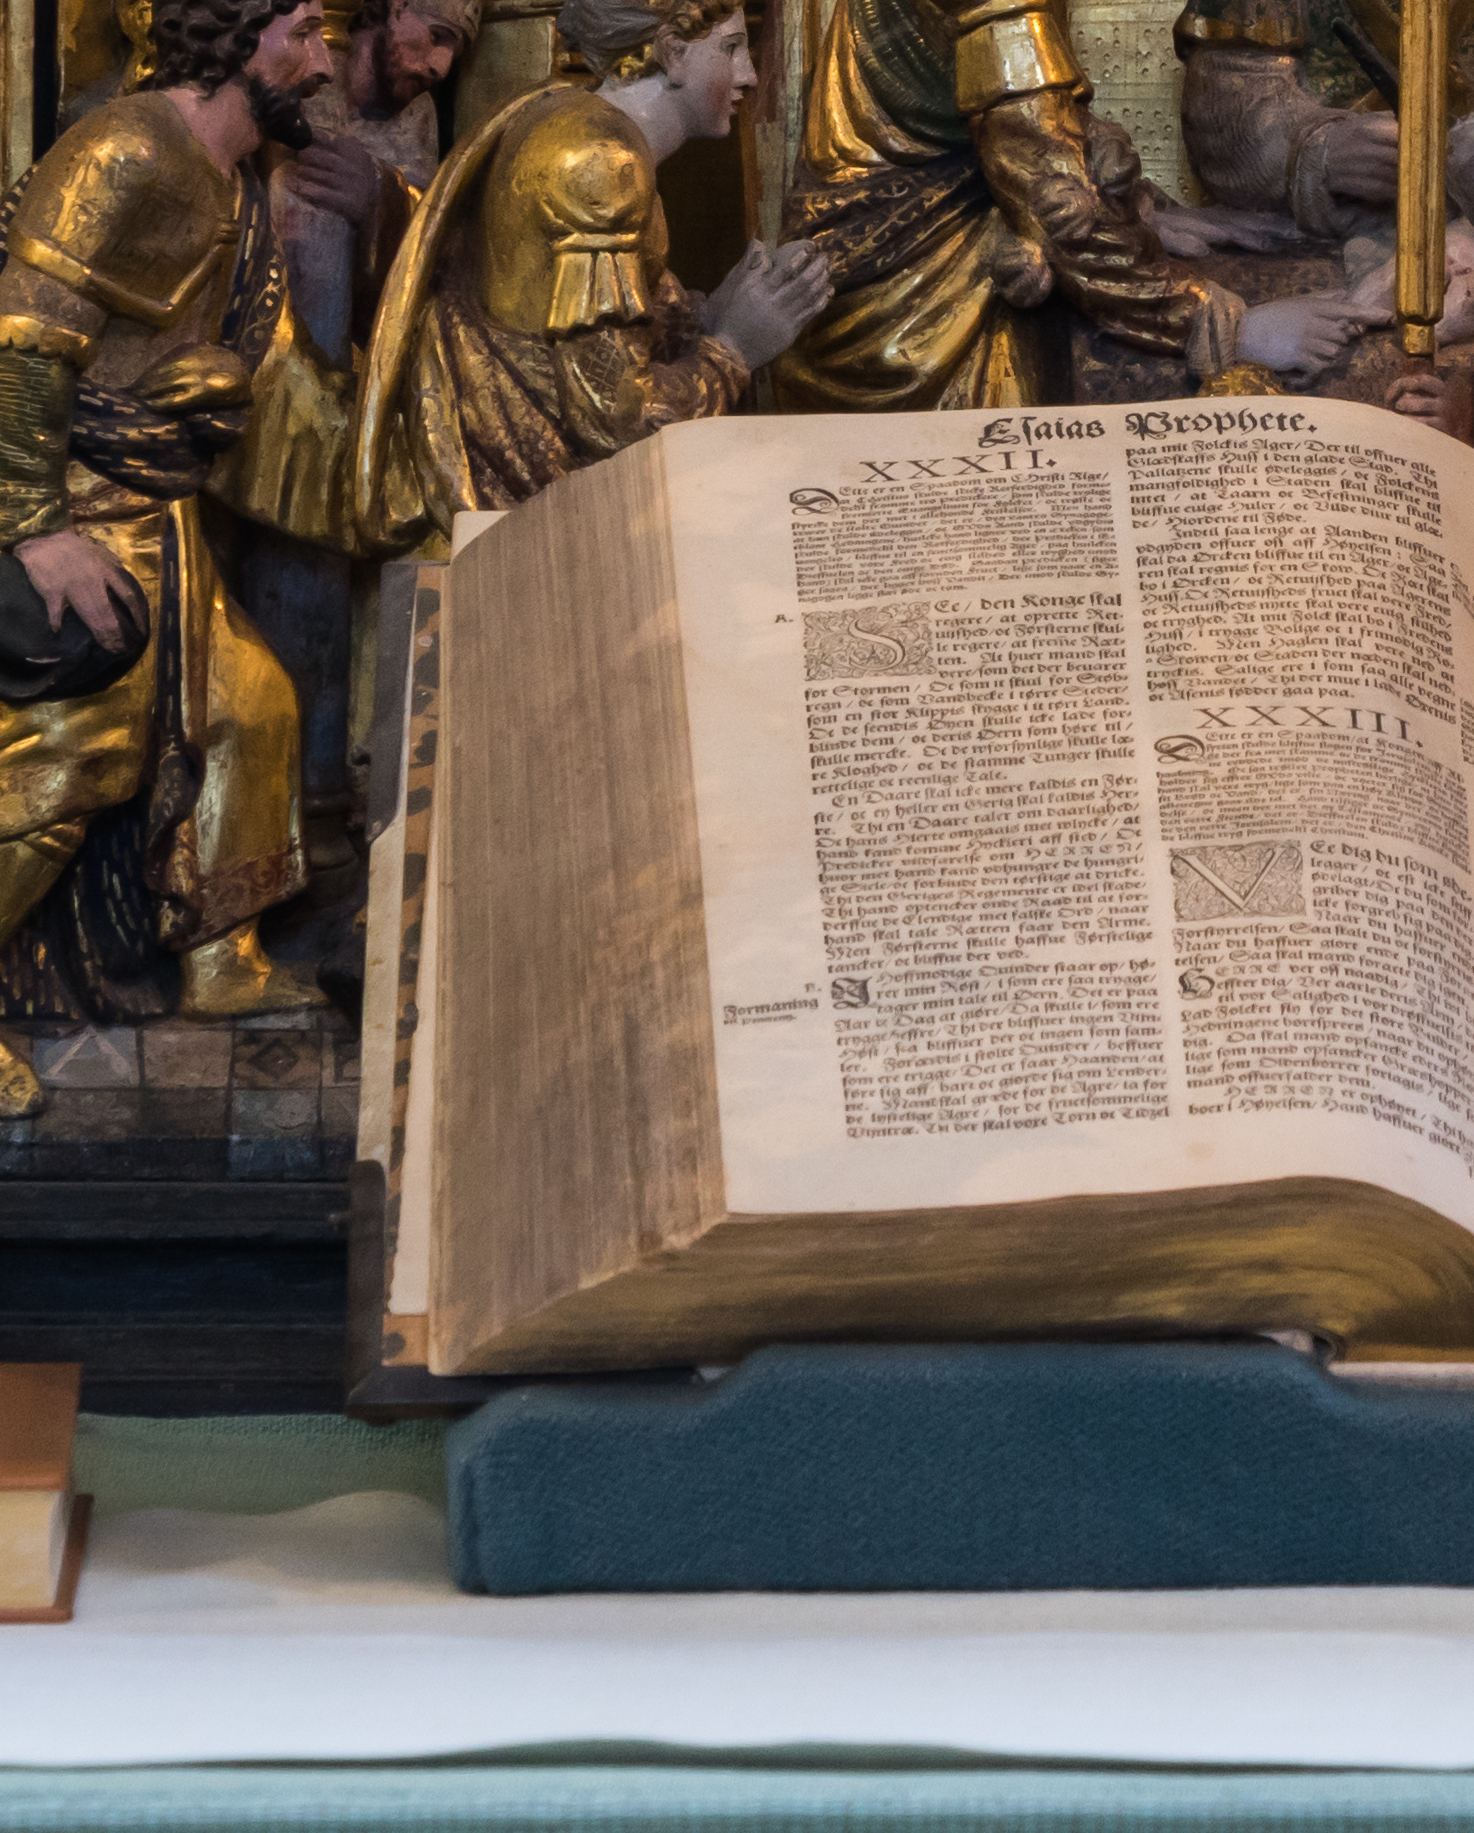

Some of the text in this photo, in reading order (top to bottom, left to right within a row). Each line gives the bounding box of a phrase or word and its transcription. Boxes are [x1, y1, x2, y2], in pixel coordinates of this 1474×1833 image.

[1125, 408, 1317, 441] Prophete.
[1126, 447, 1156, 460] paa
[859, 449, 1059, 483] XXXII.
[1266, 476, 1330, 487] Staden
[981, 595, 1085, 610] den Konge
[1049, 650, 1095, 659] mand
[832, 685, 910, 696] Stormen
[1282, 687, 1354, 698] gaa paa.
[1192, 703, 1425, 750] XXXIII.
[966, 771, 1007, 782] Tale.
[1341, 843, 1399, 865] dig du
